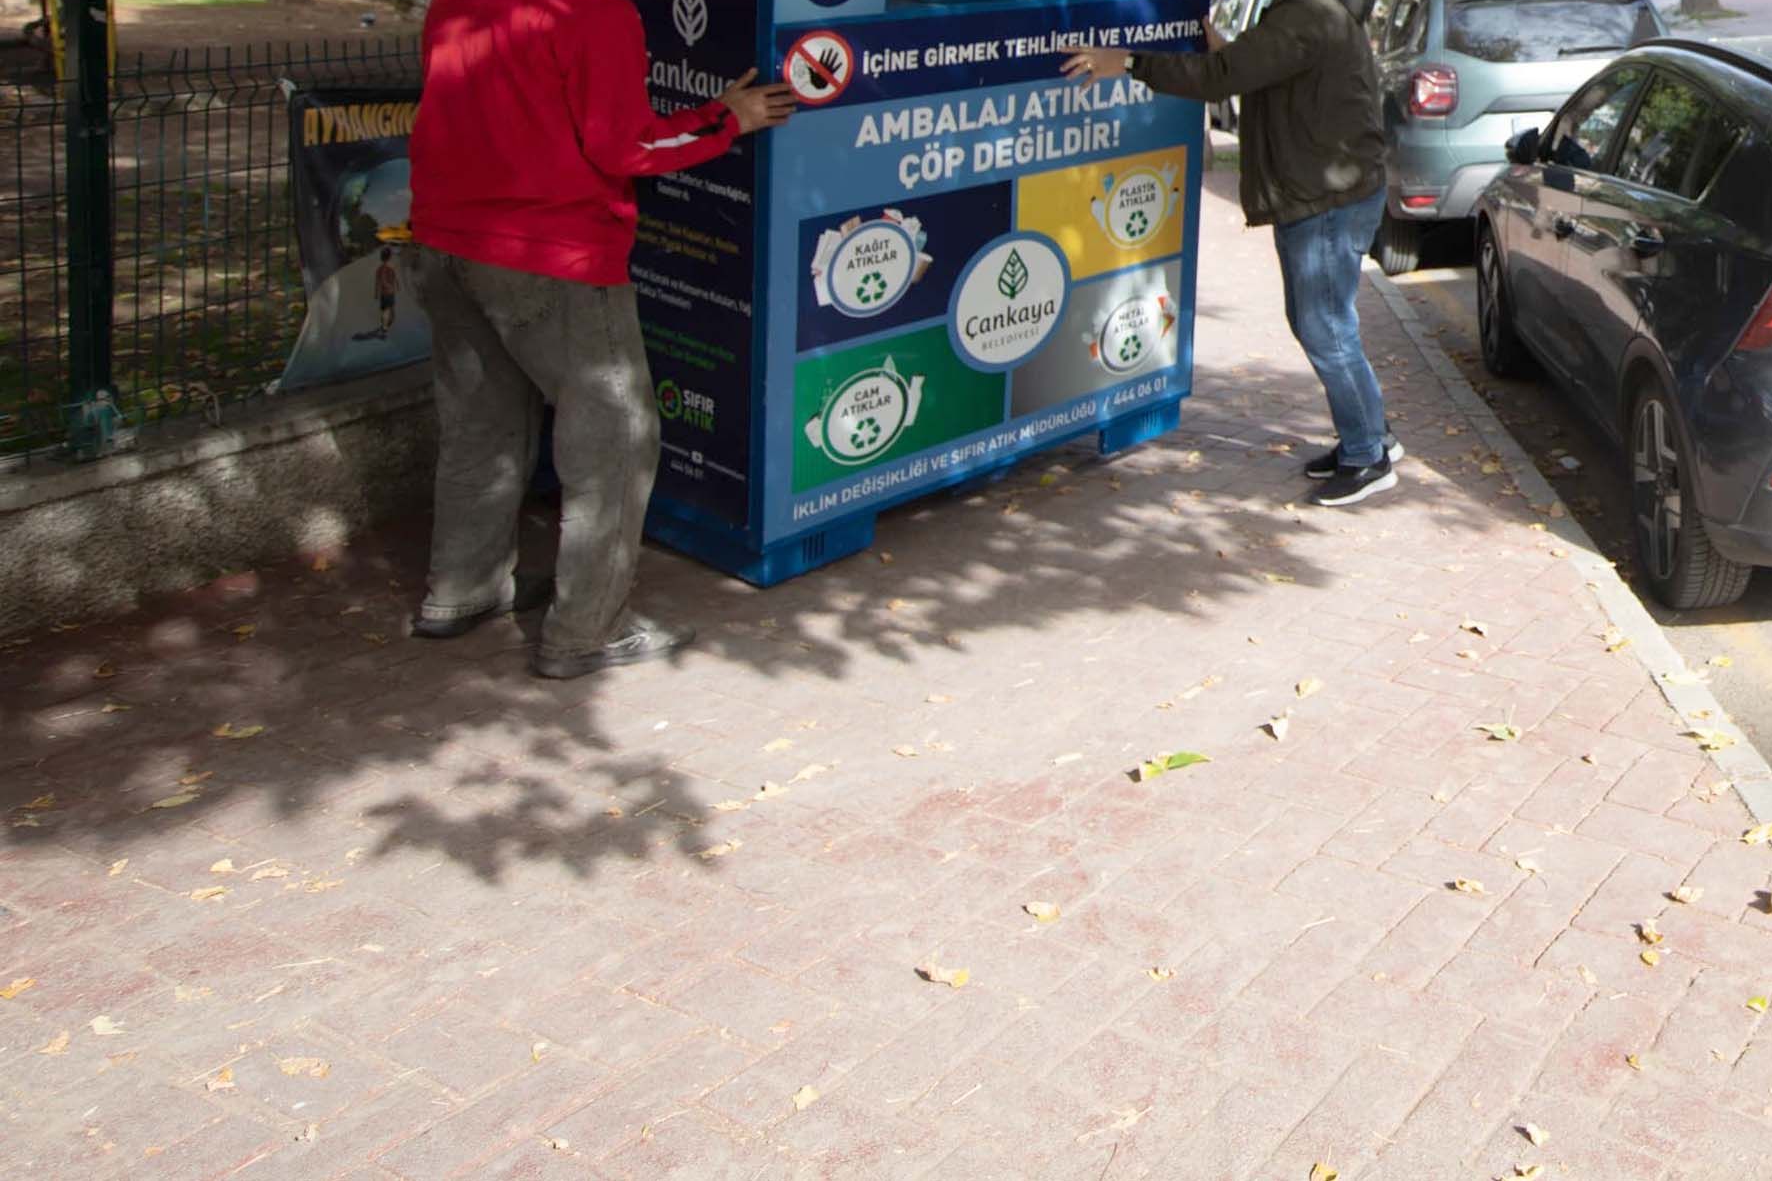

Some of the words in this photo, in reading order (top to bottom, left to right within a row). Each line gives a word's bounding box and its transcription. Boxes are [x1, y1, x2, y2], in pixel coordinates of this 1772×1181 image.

[862, 49, 918, 79] İÇİNE
[924, 40, 1000, 68] GİRMEK
[1005, 26, 1095, 59] TEHLİKELİ
[1099, 27, 1120, 47] VE
[1124, 18, 1204, 44] YASAKTIR.
[855, 93, 1016, 148] AMBALAJ
[1022, 77, 1154, 122] ATIKLARI
[899, 141, 965, 190] ÇÖP
[973, 119, 1122, 175] DEĞİLDİR!
[1118, 193, 1157, 210] ATIKLAR
[846, 250, 898, 271] ATIKLAR
[855, 238, 890, 257] KAĞIT
[964, 298, 1056, 340] Çankaya
[683, 389, 715, 415] SIFIR
[841, 394, 892, 418] ATIKLAR
[854, 385, 880, 402] CAM
[793, 492, 838, 521] İKLİM
[930, 453, 949, 472] VE
[950, 441, 987, 466] SIFIR
[988, 430, 1017, 453] ATIK
[1113, 388, 1135, 407] 444
[1137, 383, 1153, 401] 06
[1154, 375, 1169, 394] 01
